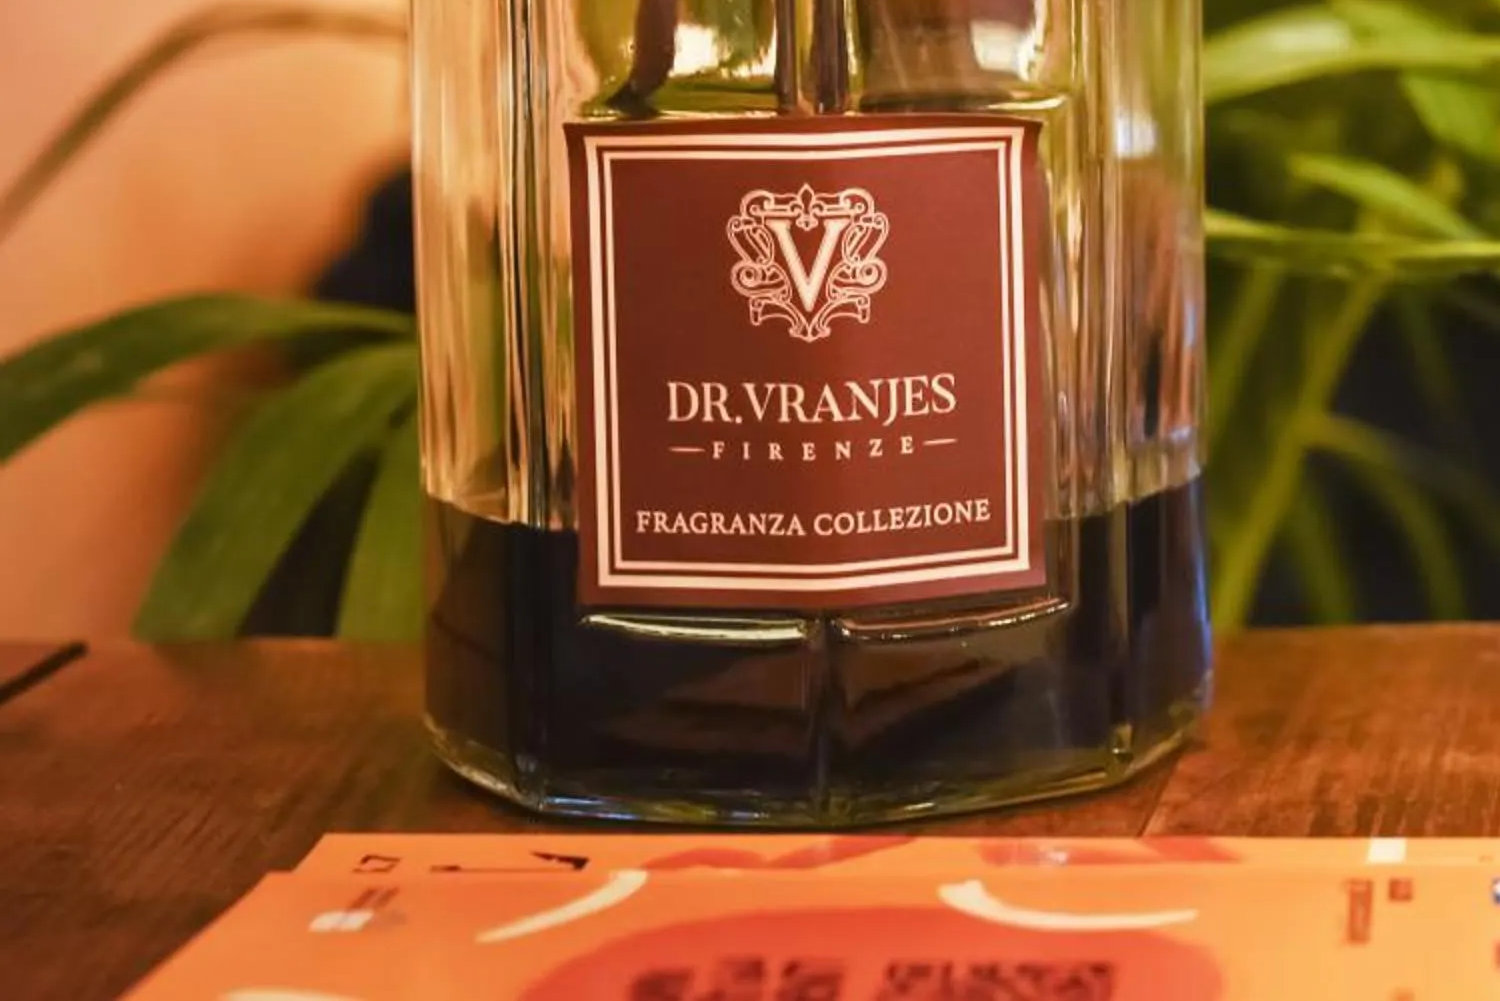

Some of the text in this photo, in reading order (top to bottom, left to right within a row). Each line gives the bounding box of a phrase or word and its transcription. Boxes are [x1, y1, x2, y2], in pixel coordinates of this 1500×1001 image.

[765, 219, 851, 312] V
[711, 436, 914, 461] FIRENZE
[636, 499, 991, 537] FRAGRANZA COLLEZIONE
